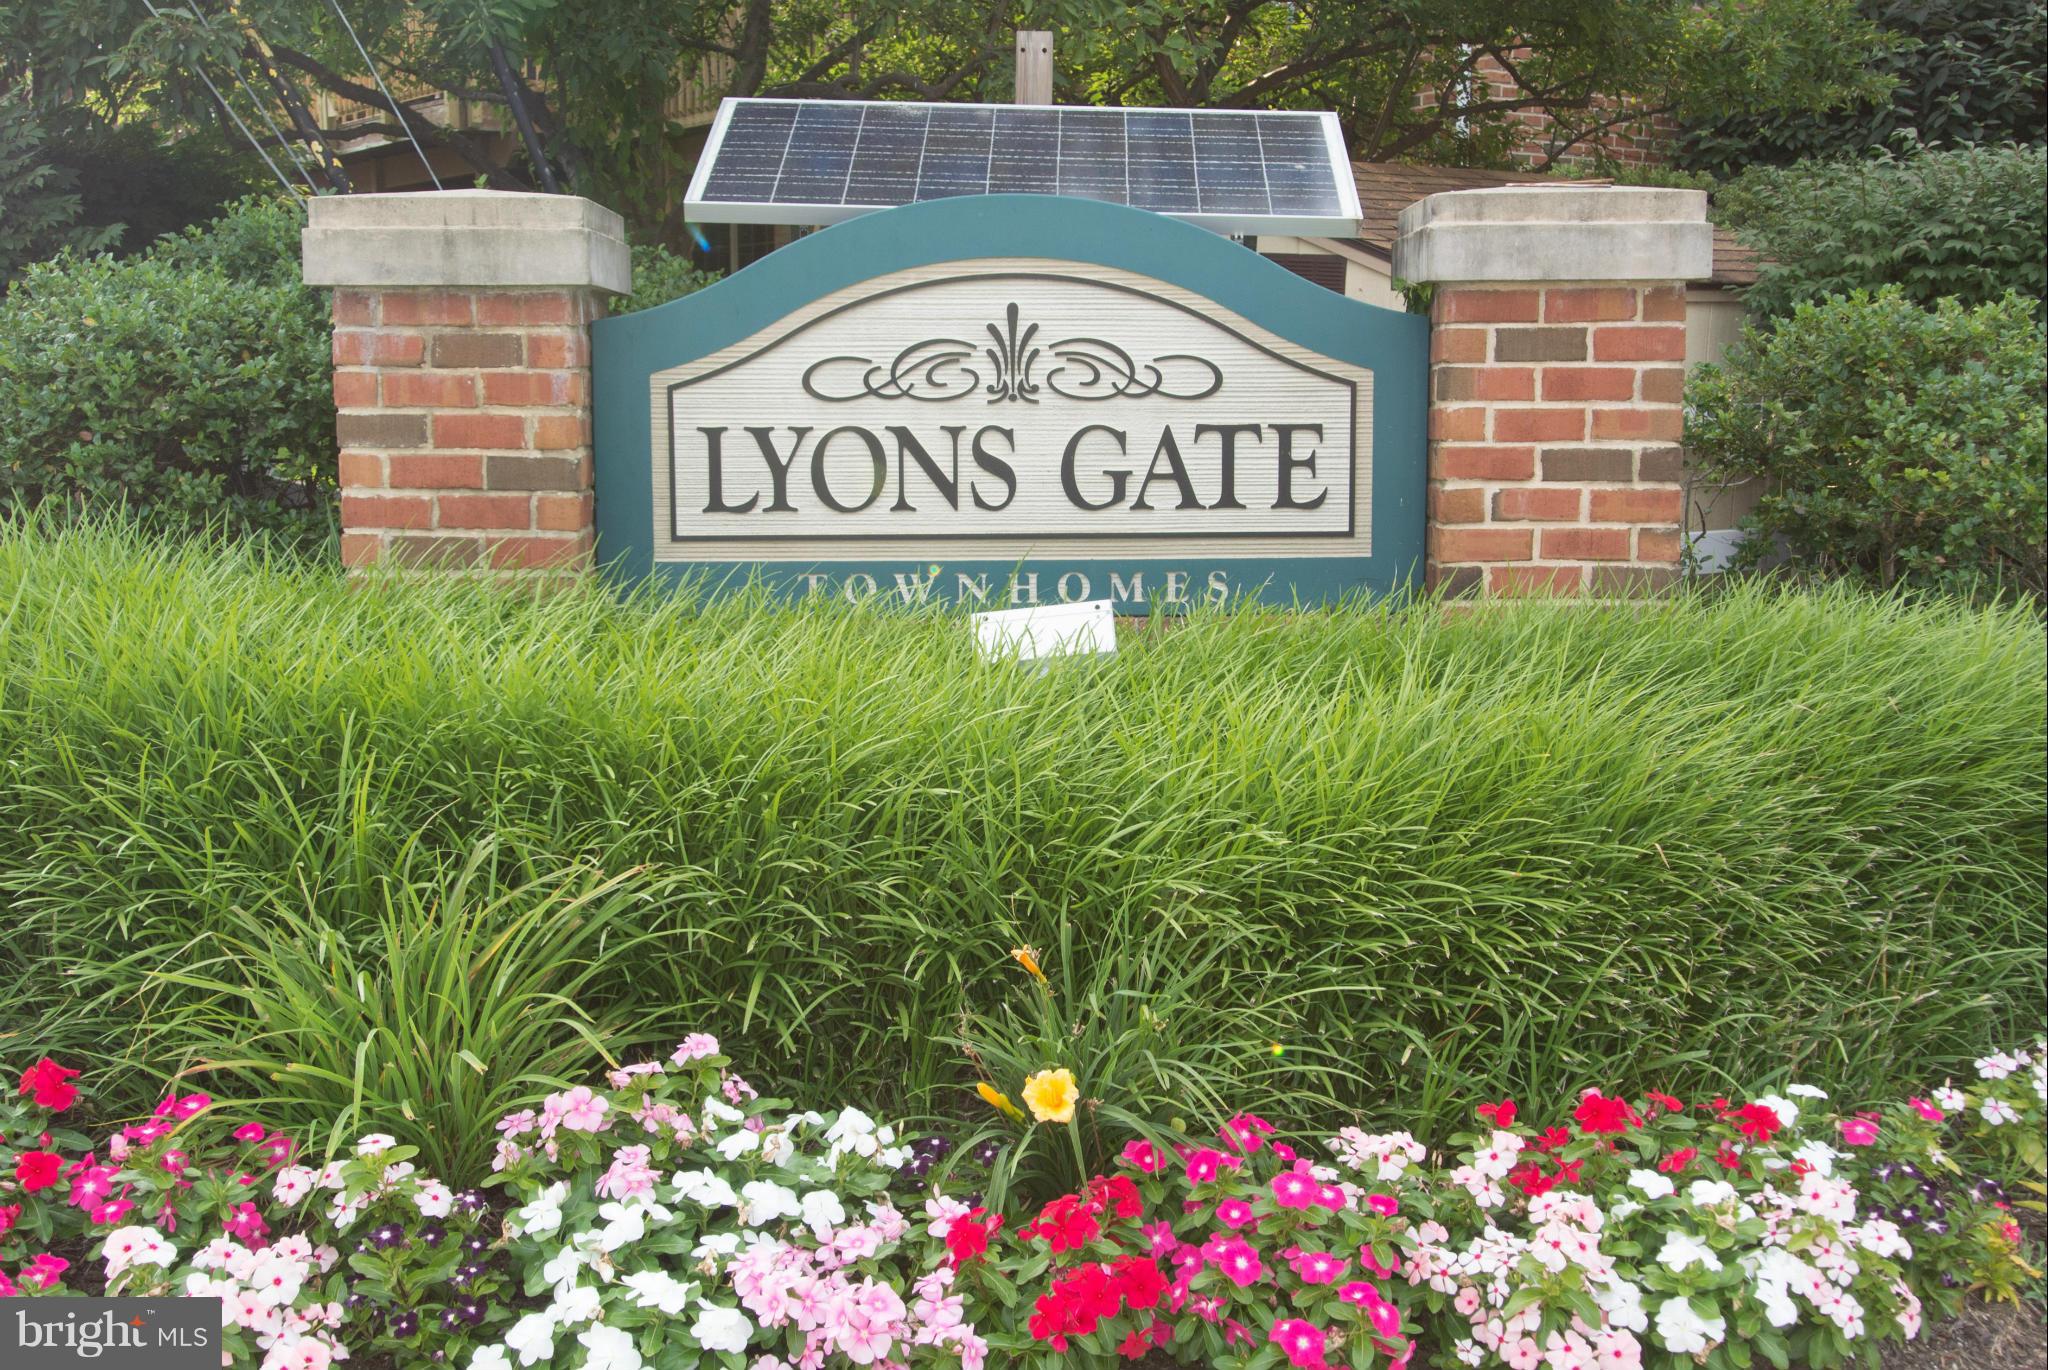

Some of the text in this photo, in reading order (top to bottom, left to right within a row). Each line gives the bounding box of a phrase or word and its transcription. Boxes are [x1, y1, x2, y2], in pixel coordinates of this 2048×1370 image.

[696, 422, 1329, 514] LYONS GATE
[801, 571, 1229, 604] TOWNHOMES
